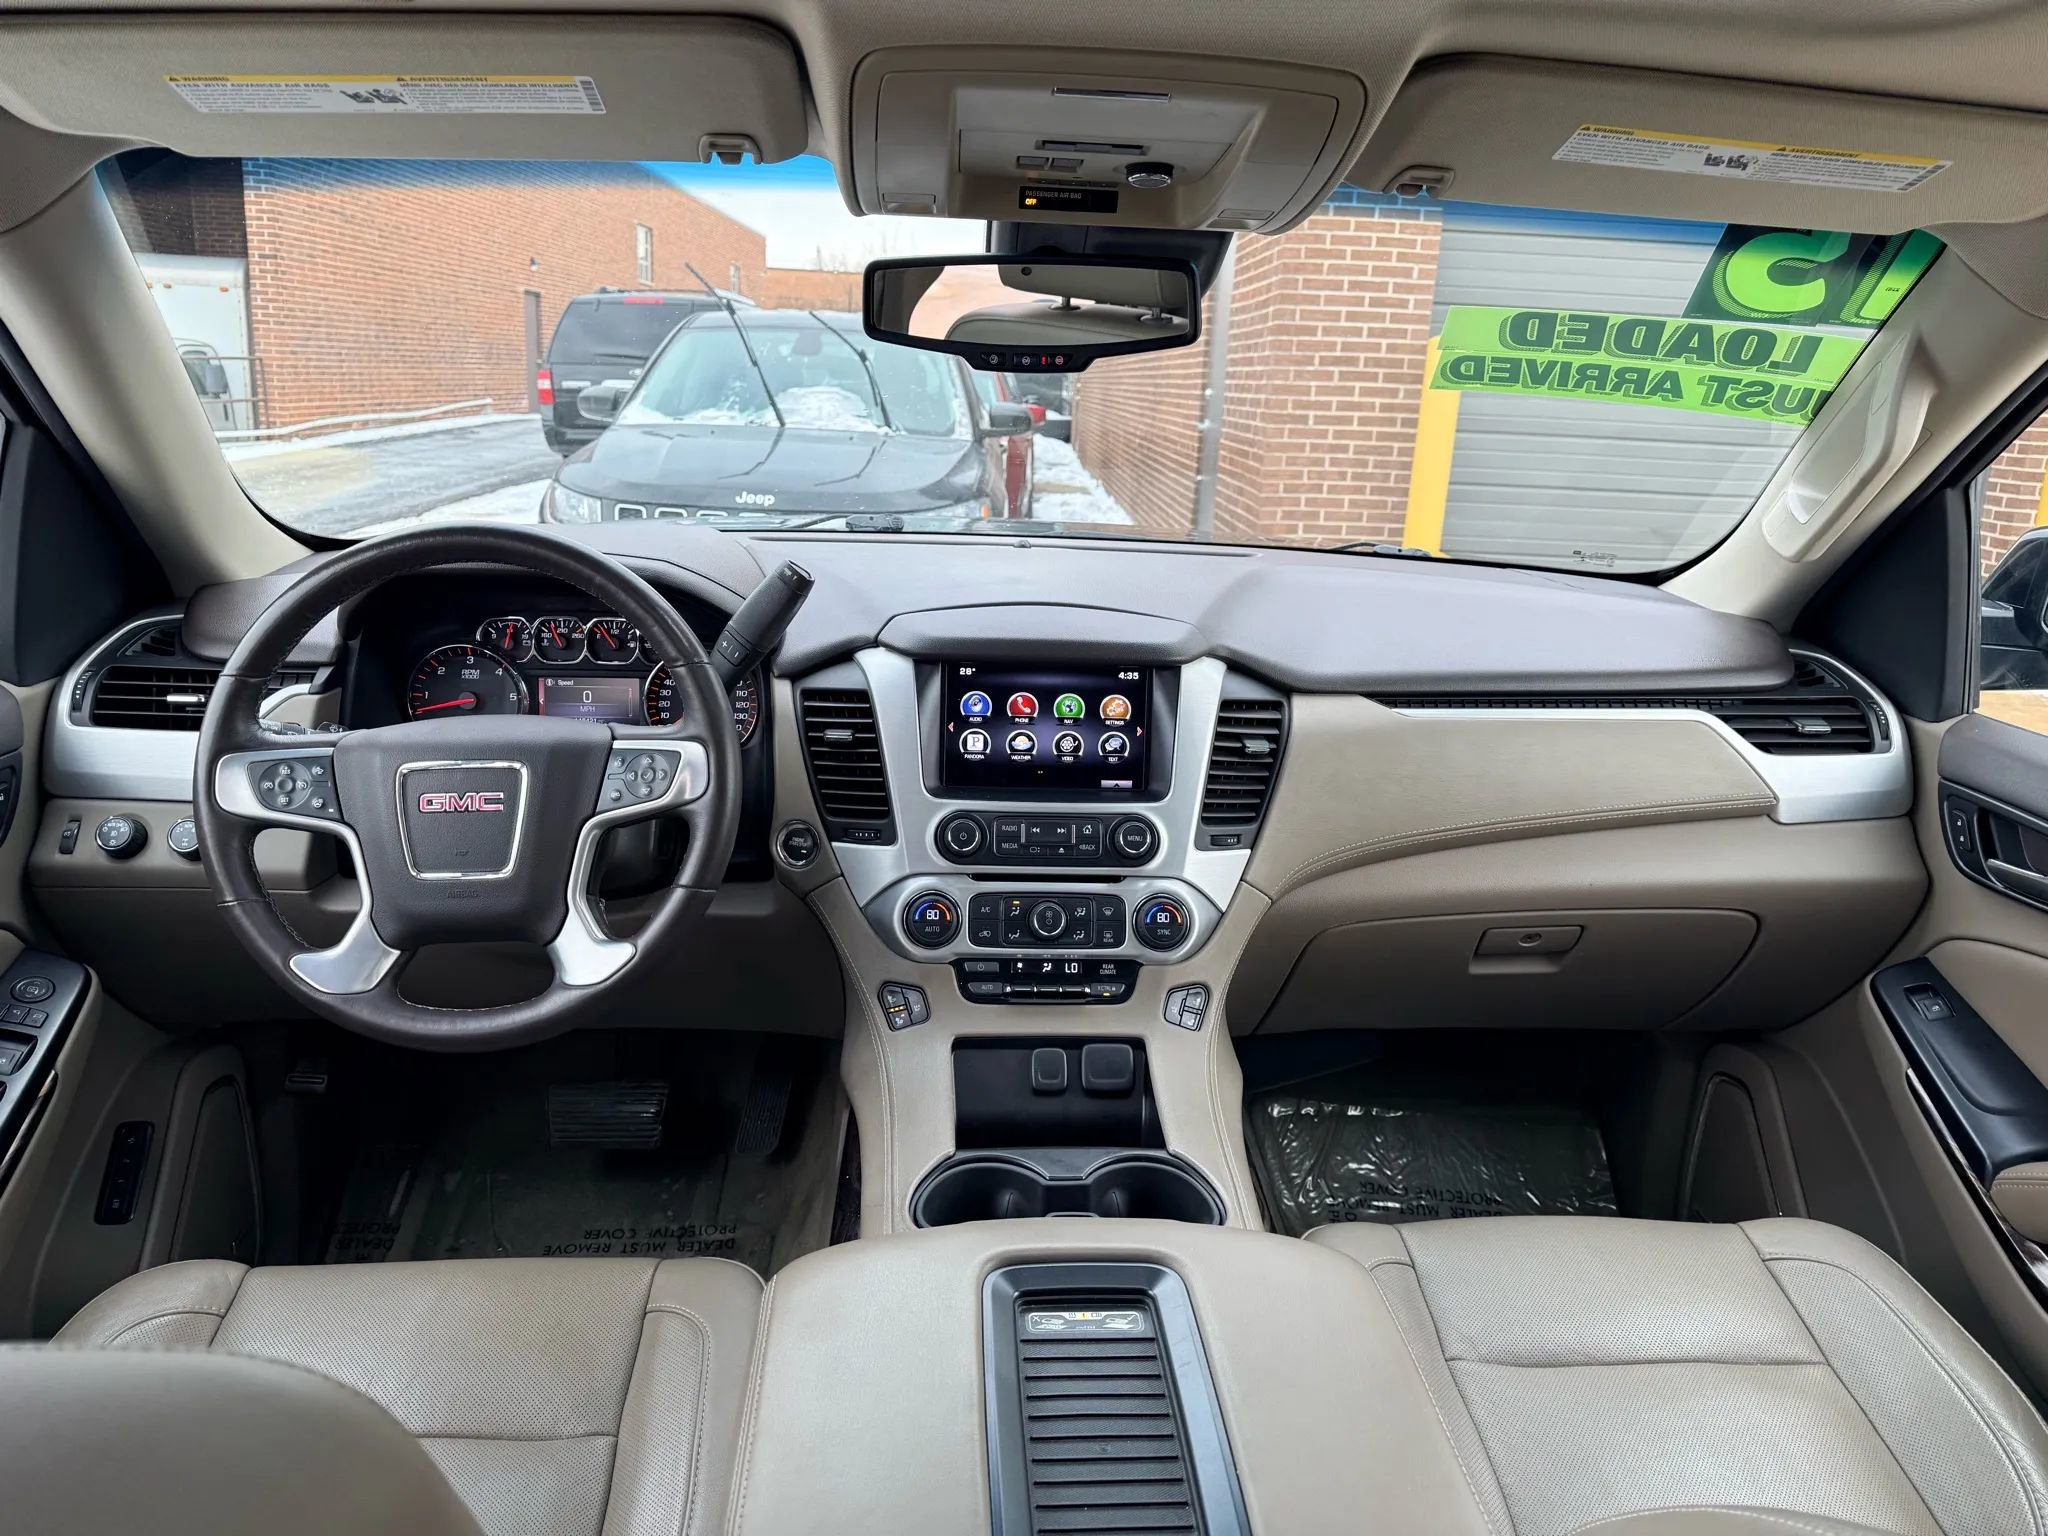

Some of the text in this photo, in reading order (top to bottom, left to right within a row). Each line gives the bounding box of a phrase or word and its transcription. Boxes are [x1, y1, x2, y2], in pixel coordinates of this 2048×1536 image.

[1593, 127, 1635, 136] WARNING
[1624, 137, 1668, 146] ADVANCED
[1790, 147, 1860, 158] AVERTISSEMENT
[1025, 190, 1059, 198] PASSENGER
[735, 491, 776, 506] Jeep
[466, 656, 474, 664] 3
[437, 666, 446, 675] 2
[495, 667, 503, 676] 4
[1118, 671, 1139, 680] 4:35
[557, 679, 574, 687] Speed
[663, 679, 675, 687] 40
[509, 693, 517, 701] 5
[583, 690, 592, 703] 0
[580, 705, 595, 713] MPH
[419, 791, 504, 813] GMC
[1001, 824, 1018, 832] RADIO
[1127, 834, 1143, 842] MENU
[447, 889, 479, 898] AIRBAG
[980, 905, 991, 914] A/C
[926, 909, 939, 920] 80
[1156, 912, 1170, 923] 80
[924, 924, 940, 933] AUTO
[1157, 928, 1171, 936] SYNC
[1065, 962, 1078, 973] LO
[1360, 1181, 1408, 1196] COVER
[1400, 1200, 1440, 1216] MUST
[582, 1224, 737, 1240] PROTECTIVE COVER
[542, 1238, 736, 1257] DEALER MUST REMOVE
